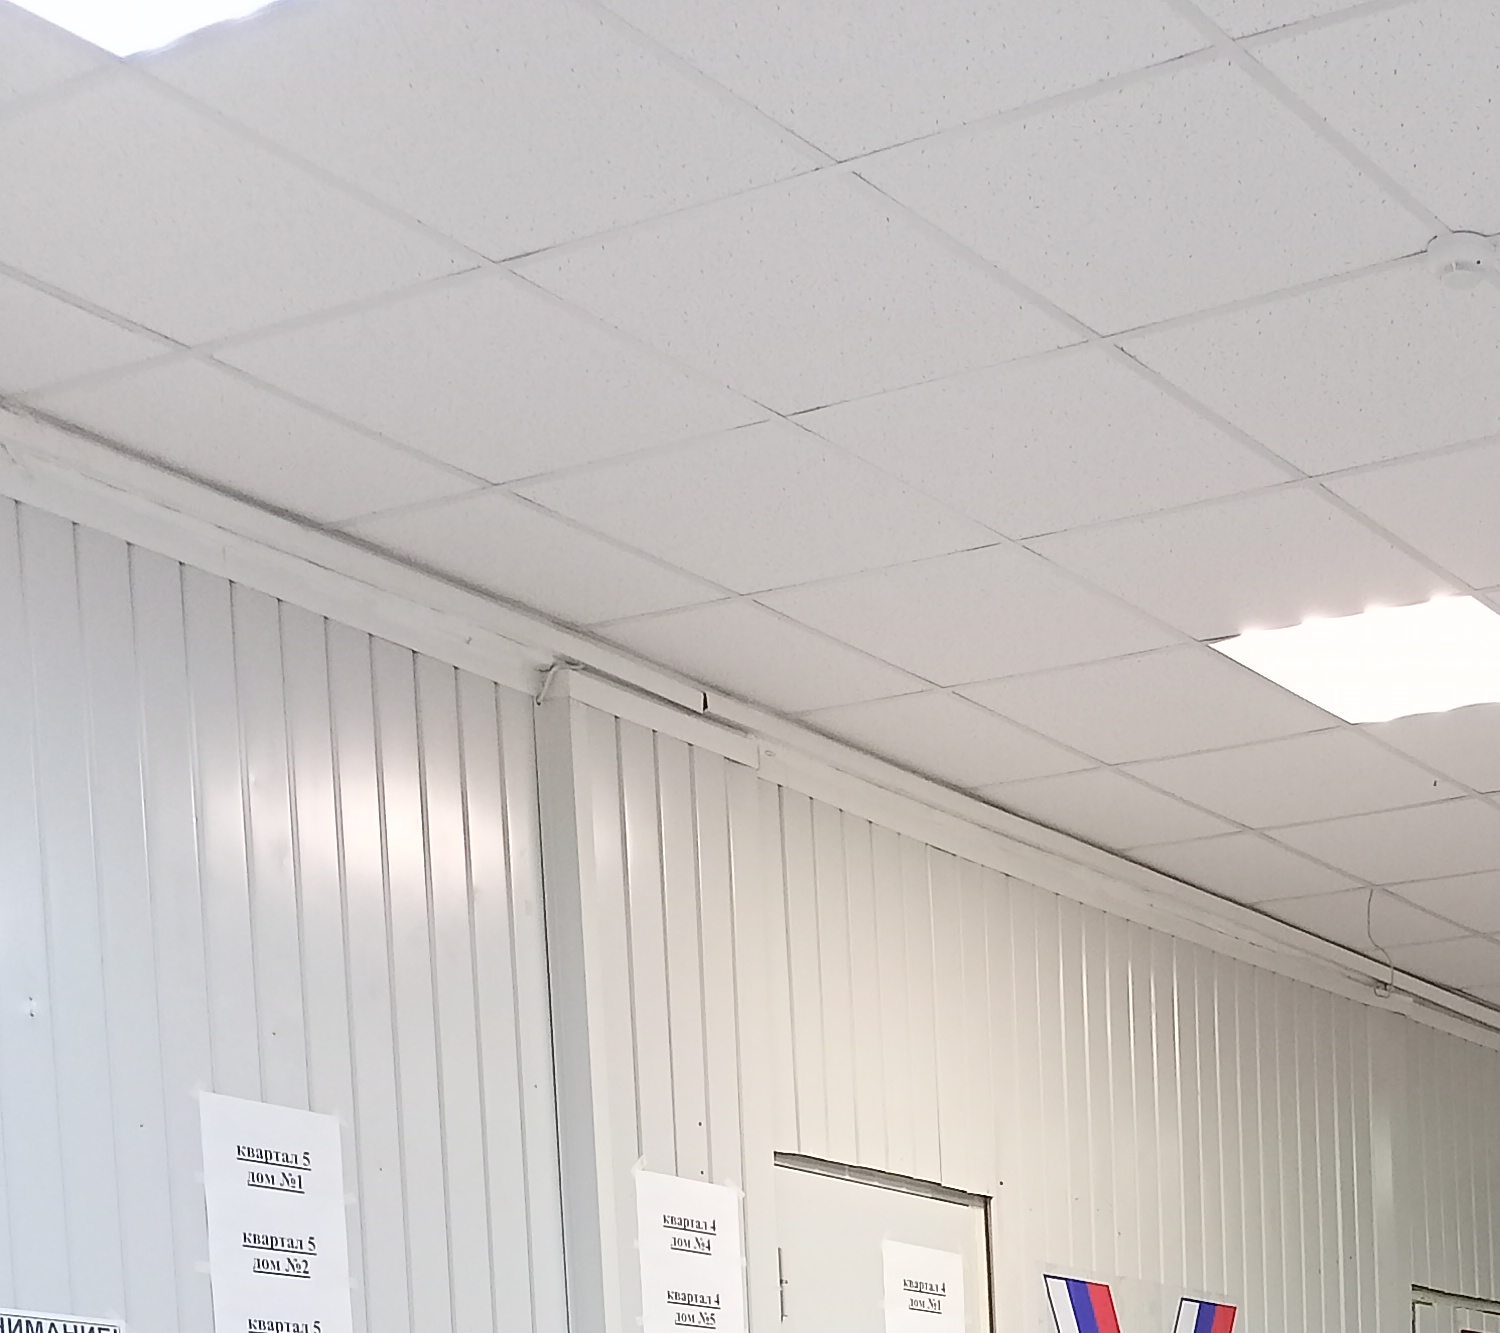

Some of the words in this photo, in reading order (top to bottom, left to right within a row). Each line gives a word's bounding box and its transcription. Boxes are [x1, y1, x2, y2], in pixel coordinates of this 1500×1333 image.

[236, 1144, 298, 1166] квартал
[302, 1151, 312, 1166] 5
[248, 1171, 276, 1187] дом
[280, 1172, 304, 1190] №1
[663, 1214, 708, 1231] квартал
[710, 1219, 717, 1232] 4
[242, 1232, 304, 1250] квартал
[307, 1236, 317, 1251] 5
[671, 1237, 691, 1250] дом
[253, 1257, 281, 1272] дом
[285, 1257, 311, 1275] №2
[667, 1290, 712, 1306] квартал
[714, 1293, 721, 1306] 4
[675, 1312, 695, 1325] дом
[698, 1311, 716, 1325] №5
